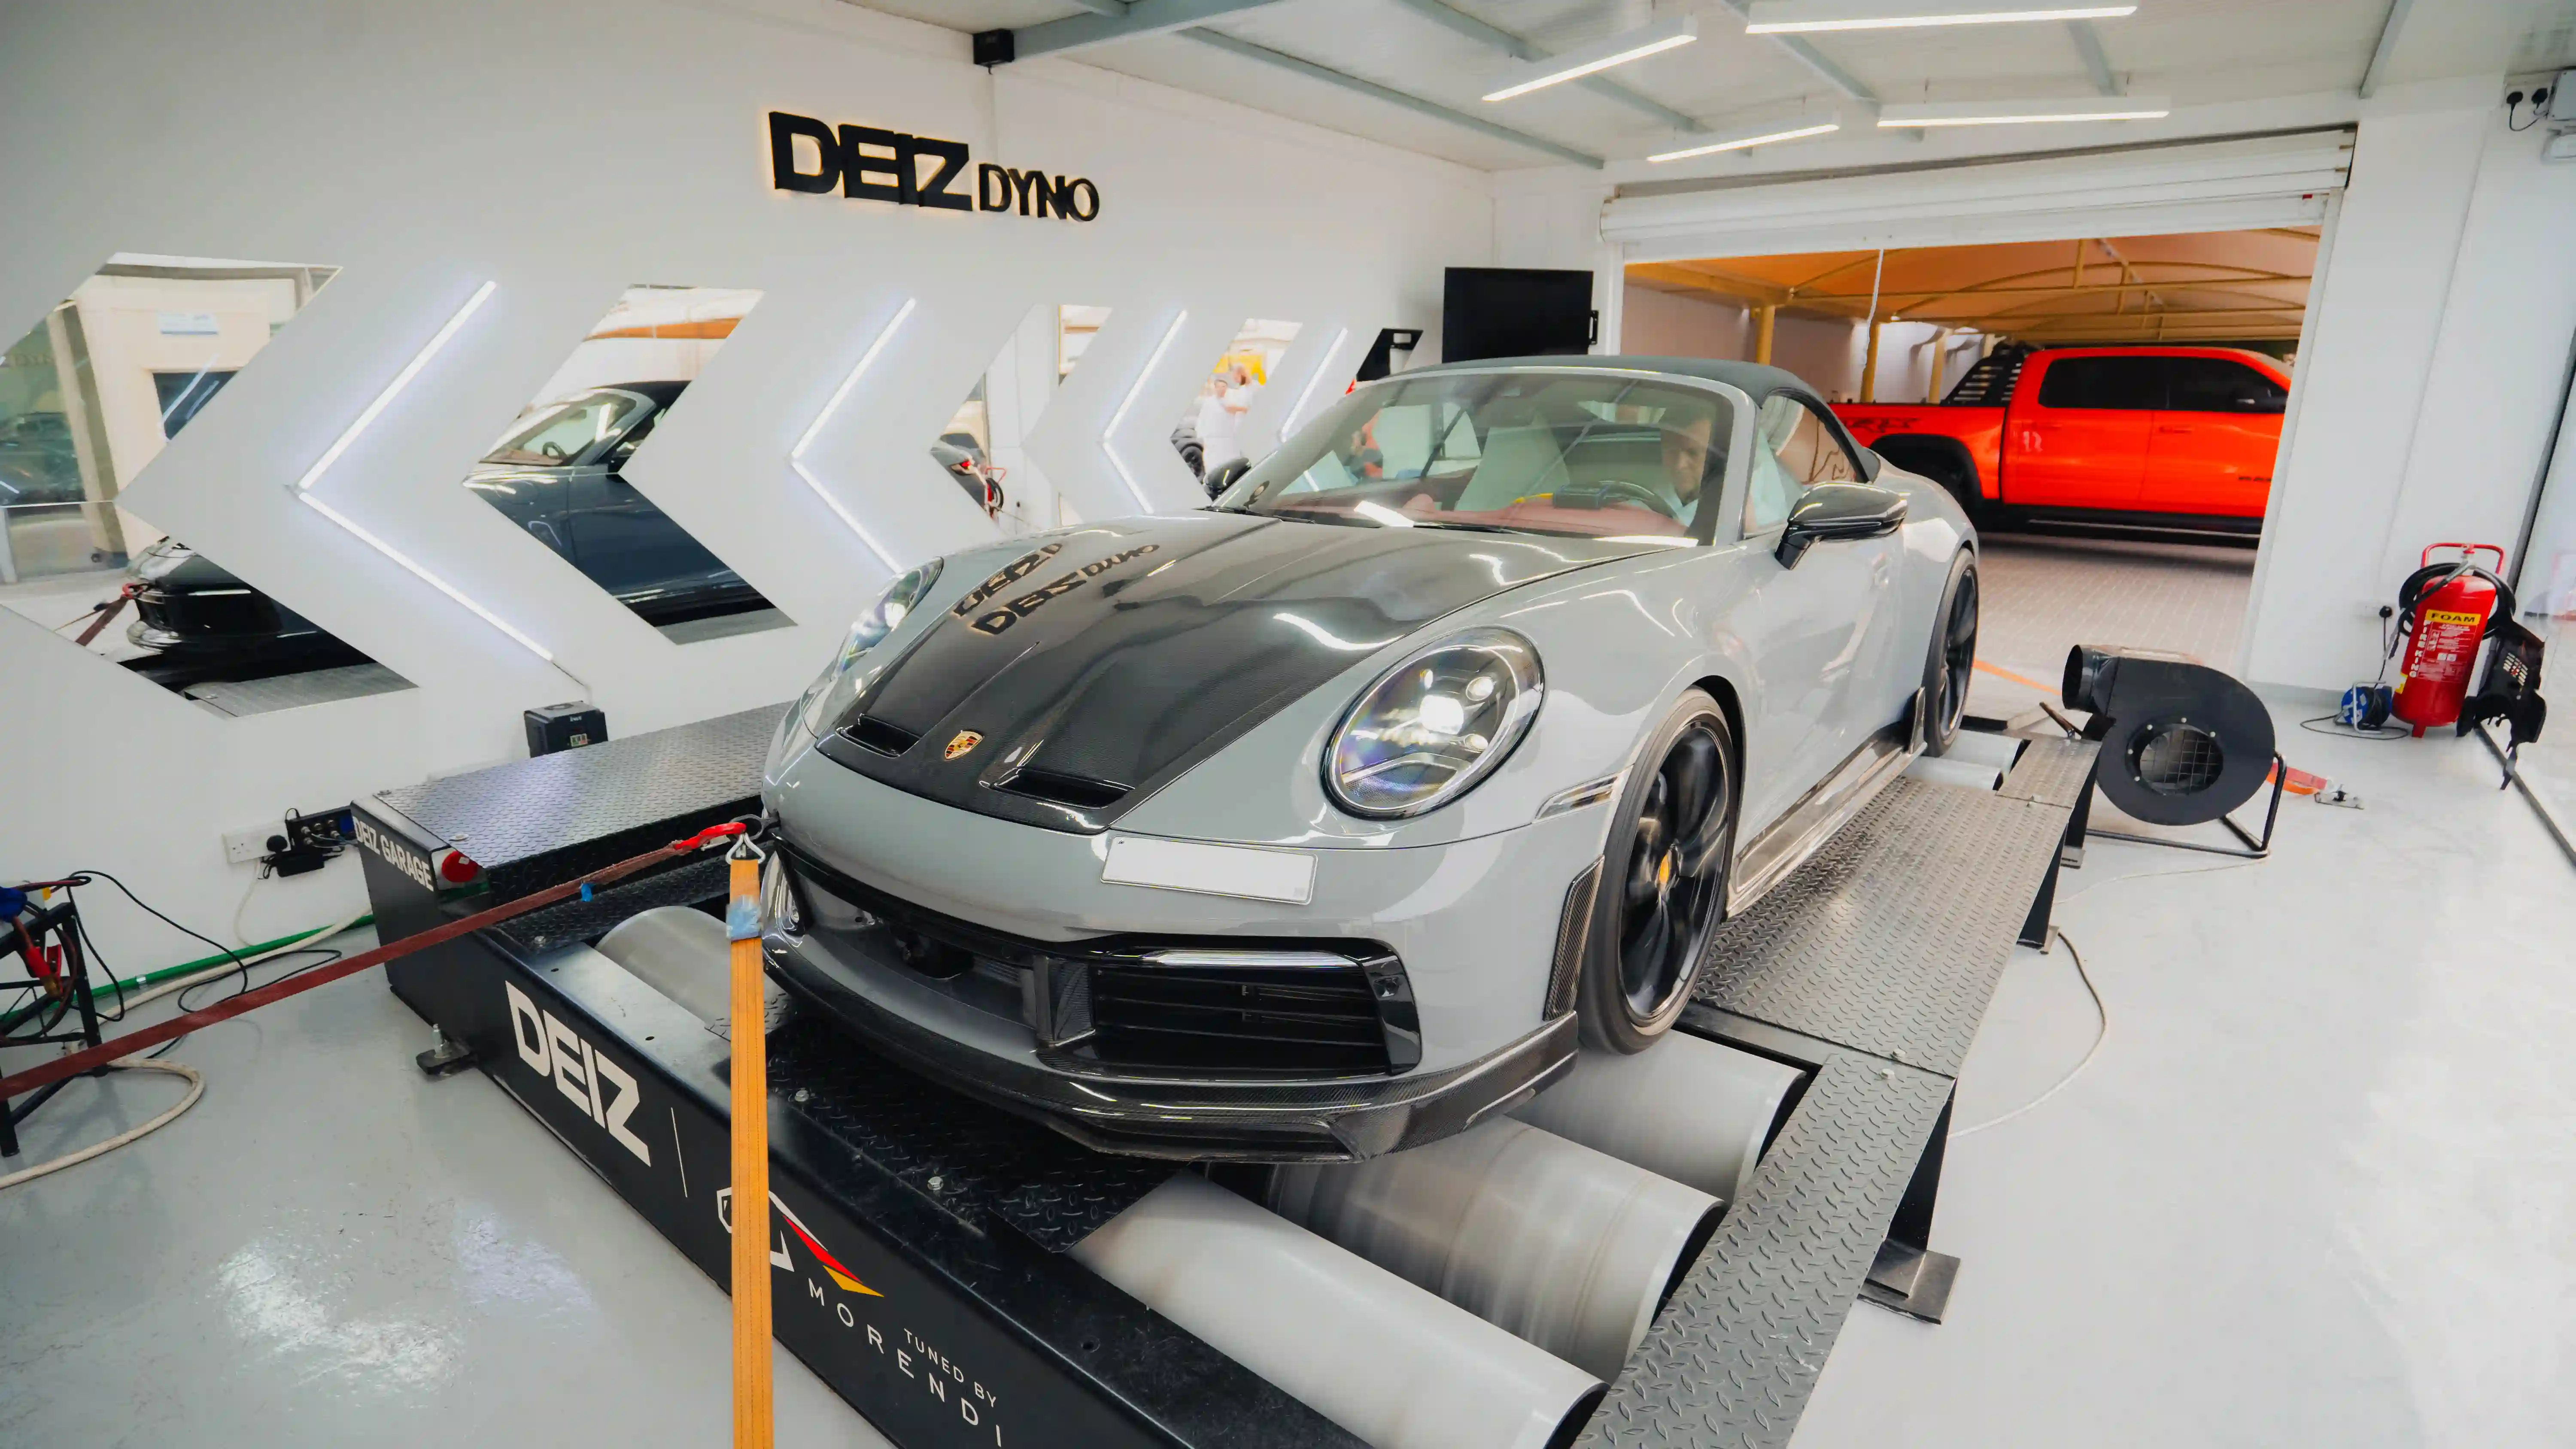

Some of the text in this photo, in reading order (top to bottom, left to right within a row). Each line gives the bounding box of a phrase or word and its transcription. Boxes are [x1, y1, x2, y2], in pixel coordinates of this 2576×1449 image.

[769, 111, 1100, 222] DEIZ DYNO
[2431, 612, 2476, 622] FOAM
[352, 815, 434, 891] DEIZ GARAGE
[505, 980, 651, 1167] DEIZ
[808, 1278, 1001, 1447] MORENDI
[904, 1328, 996, 1407] TUNED BY
